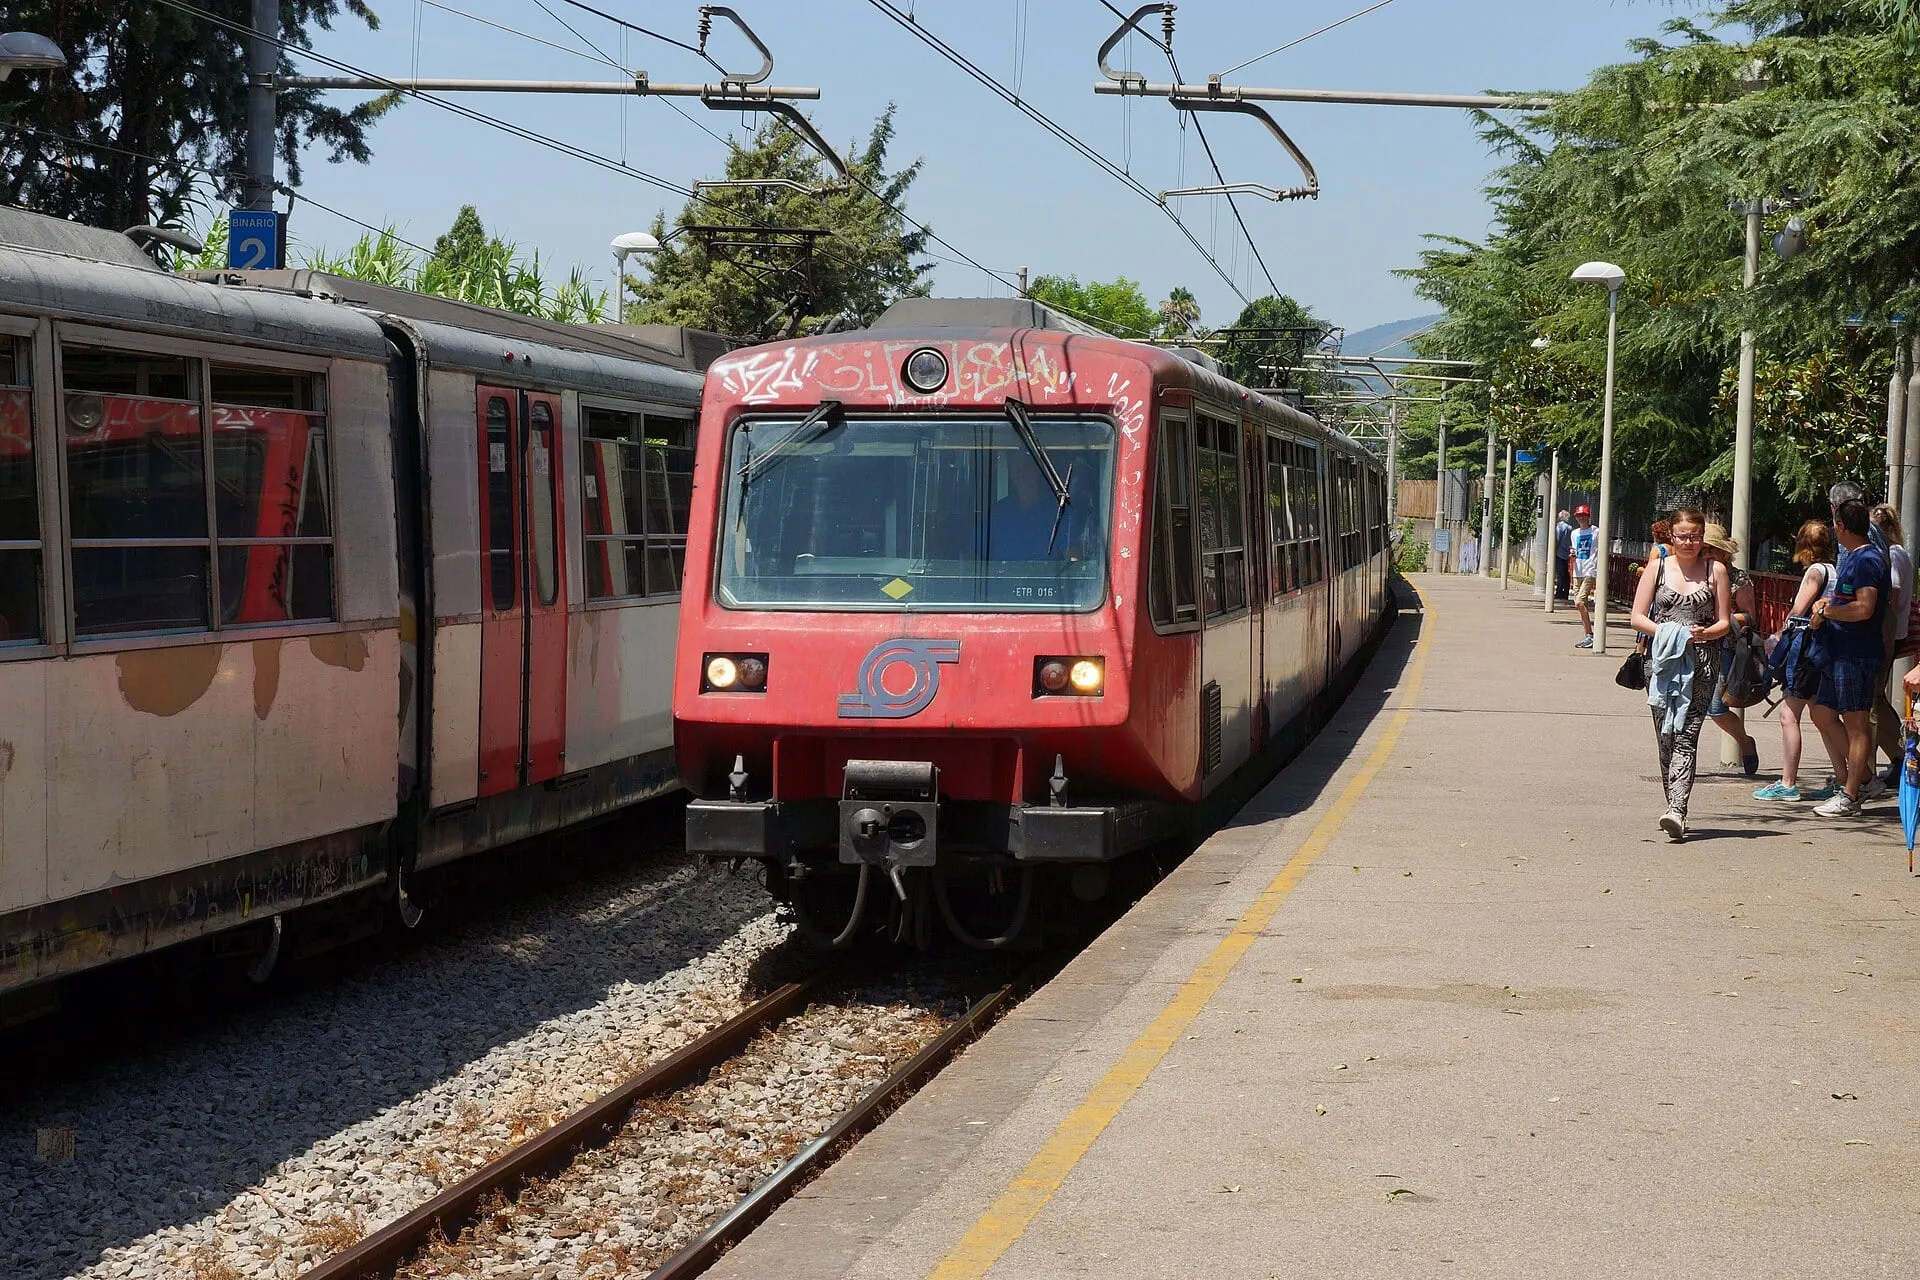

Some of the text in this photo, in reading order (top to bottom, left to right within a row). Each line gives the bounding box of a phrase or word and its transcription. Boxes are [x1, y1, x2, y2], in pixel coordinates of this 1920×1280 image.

[232, 218, 274, 228] BINARIO
[239, 238, 266, 270] 2
[1016, 587, 1053, 597] ETR 016
